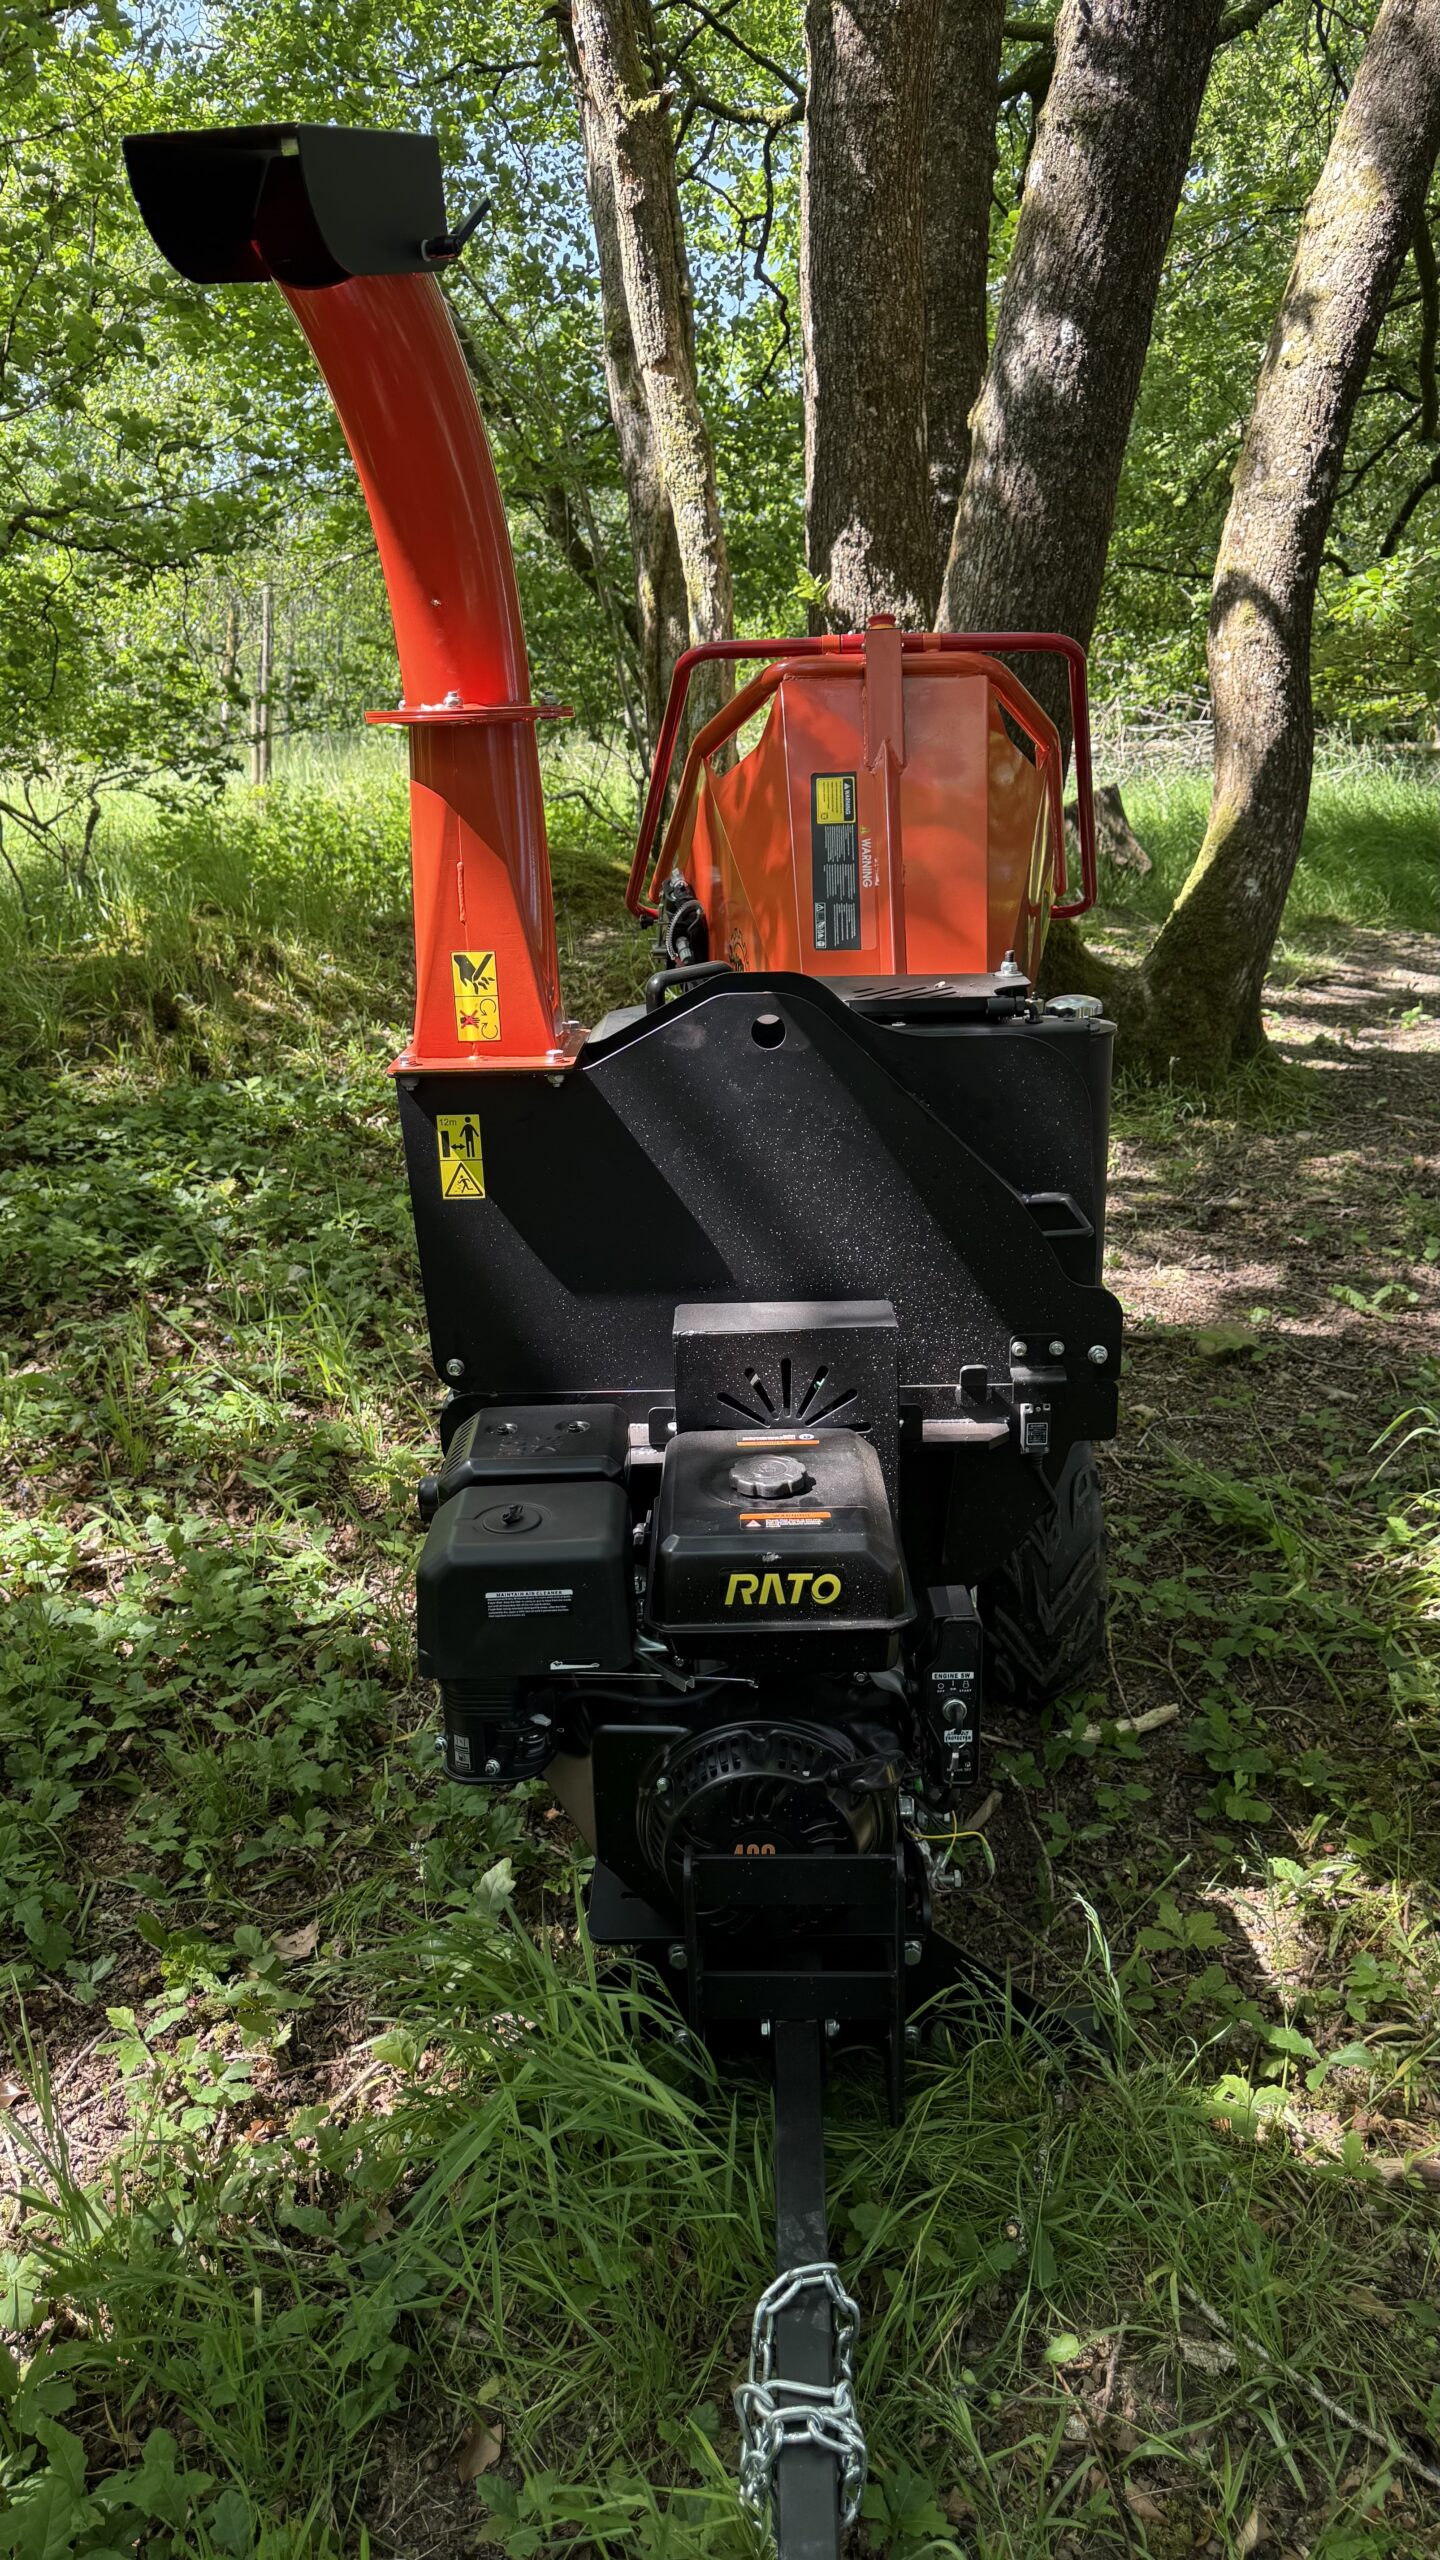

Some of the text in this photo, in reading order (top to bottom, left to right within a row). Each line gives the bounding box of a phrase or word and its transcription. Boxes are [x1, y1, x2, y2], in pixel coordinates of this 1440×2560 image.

[844, 790, 852, 815] WARNING
[861, 838, 873, 888] WARNING
[440, 1118, 457, 1126] 12m
[724, 1573, 842, 1605] RATO
